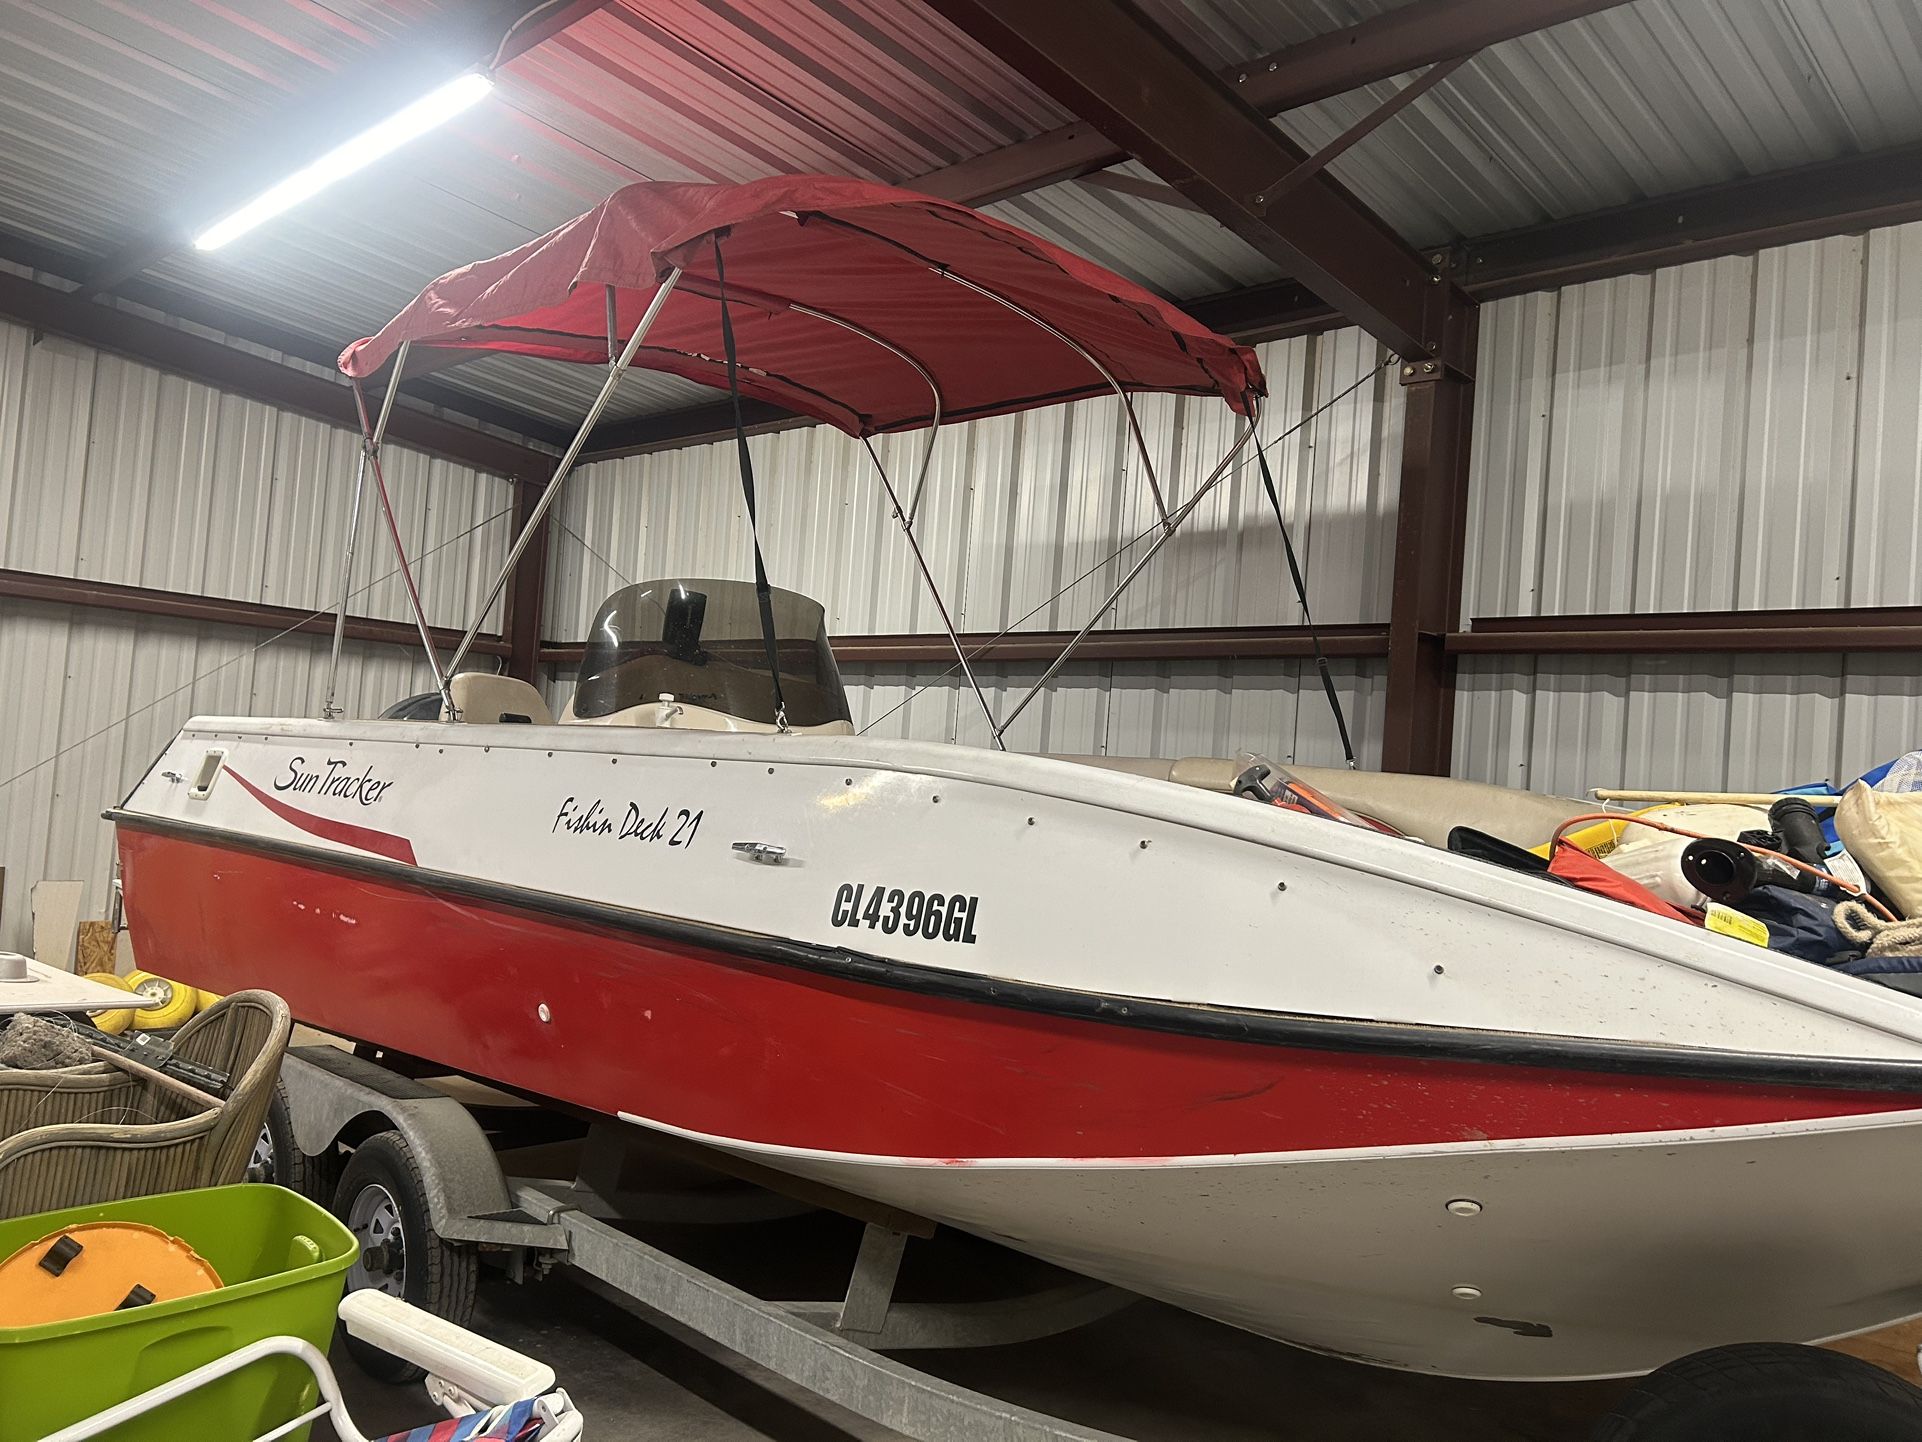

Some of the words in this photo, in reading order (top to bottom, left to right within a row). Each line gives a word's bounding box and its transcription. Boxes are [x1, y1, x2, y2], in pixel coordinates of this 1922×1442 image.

[274, 756, 319, 793] Sun
[318, 758, 394, 806] Tracker
[552, 796, 612, 835] Fishin
[618, 801, 669, 842] Deck
[668, 809, 704, 849] 21
[831, 883, 979, 944] CL4396GL
